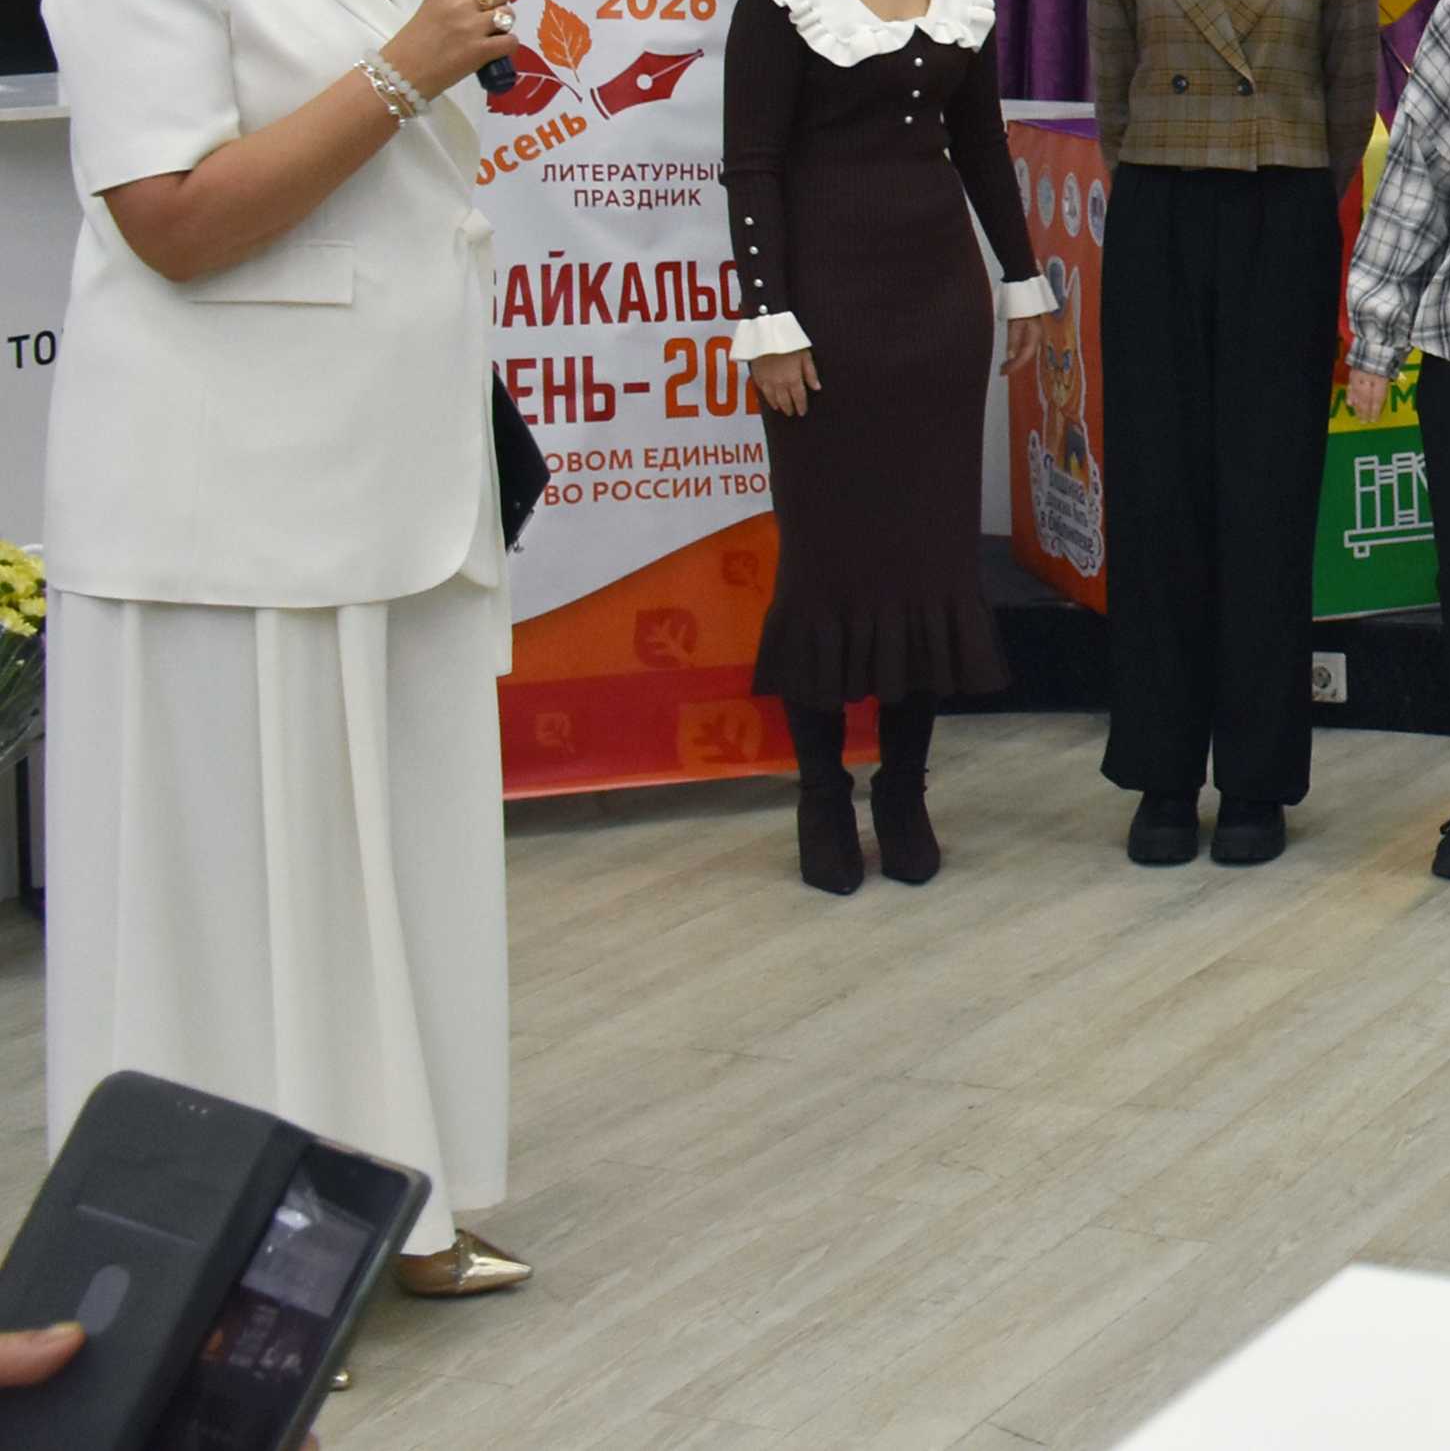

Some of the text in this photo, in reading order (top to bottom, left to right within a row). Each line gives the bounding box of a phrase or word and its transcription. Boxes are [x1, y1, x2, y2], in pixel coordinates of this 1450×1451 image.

[476, 112, 587, 186] осень
[541, 162, 722, 183] ЛИТЕРАТУРНЫ
[573, 187, 702, 210] ПРАЗДНИК
[493, 250, 743, 328] АЙКАЛЬС
[6, 328, 64, 369] ТО
[644, 443, 764, 471] ЕДИНЫМ
[592, 476, 718, 502] РОССИИ
[719, 473, 769, 496] ТВО
